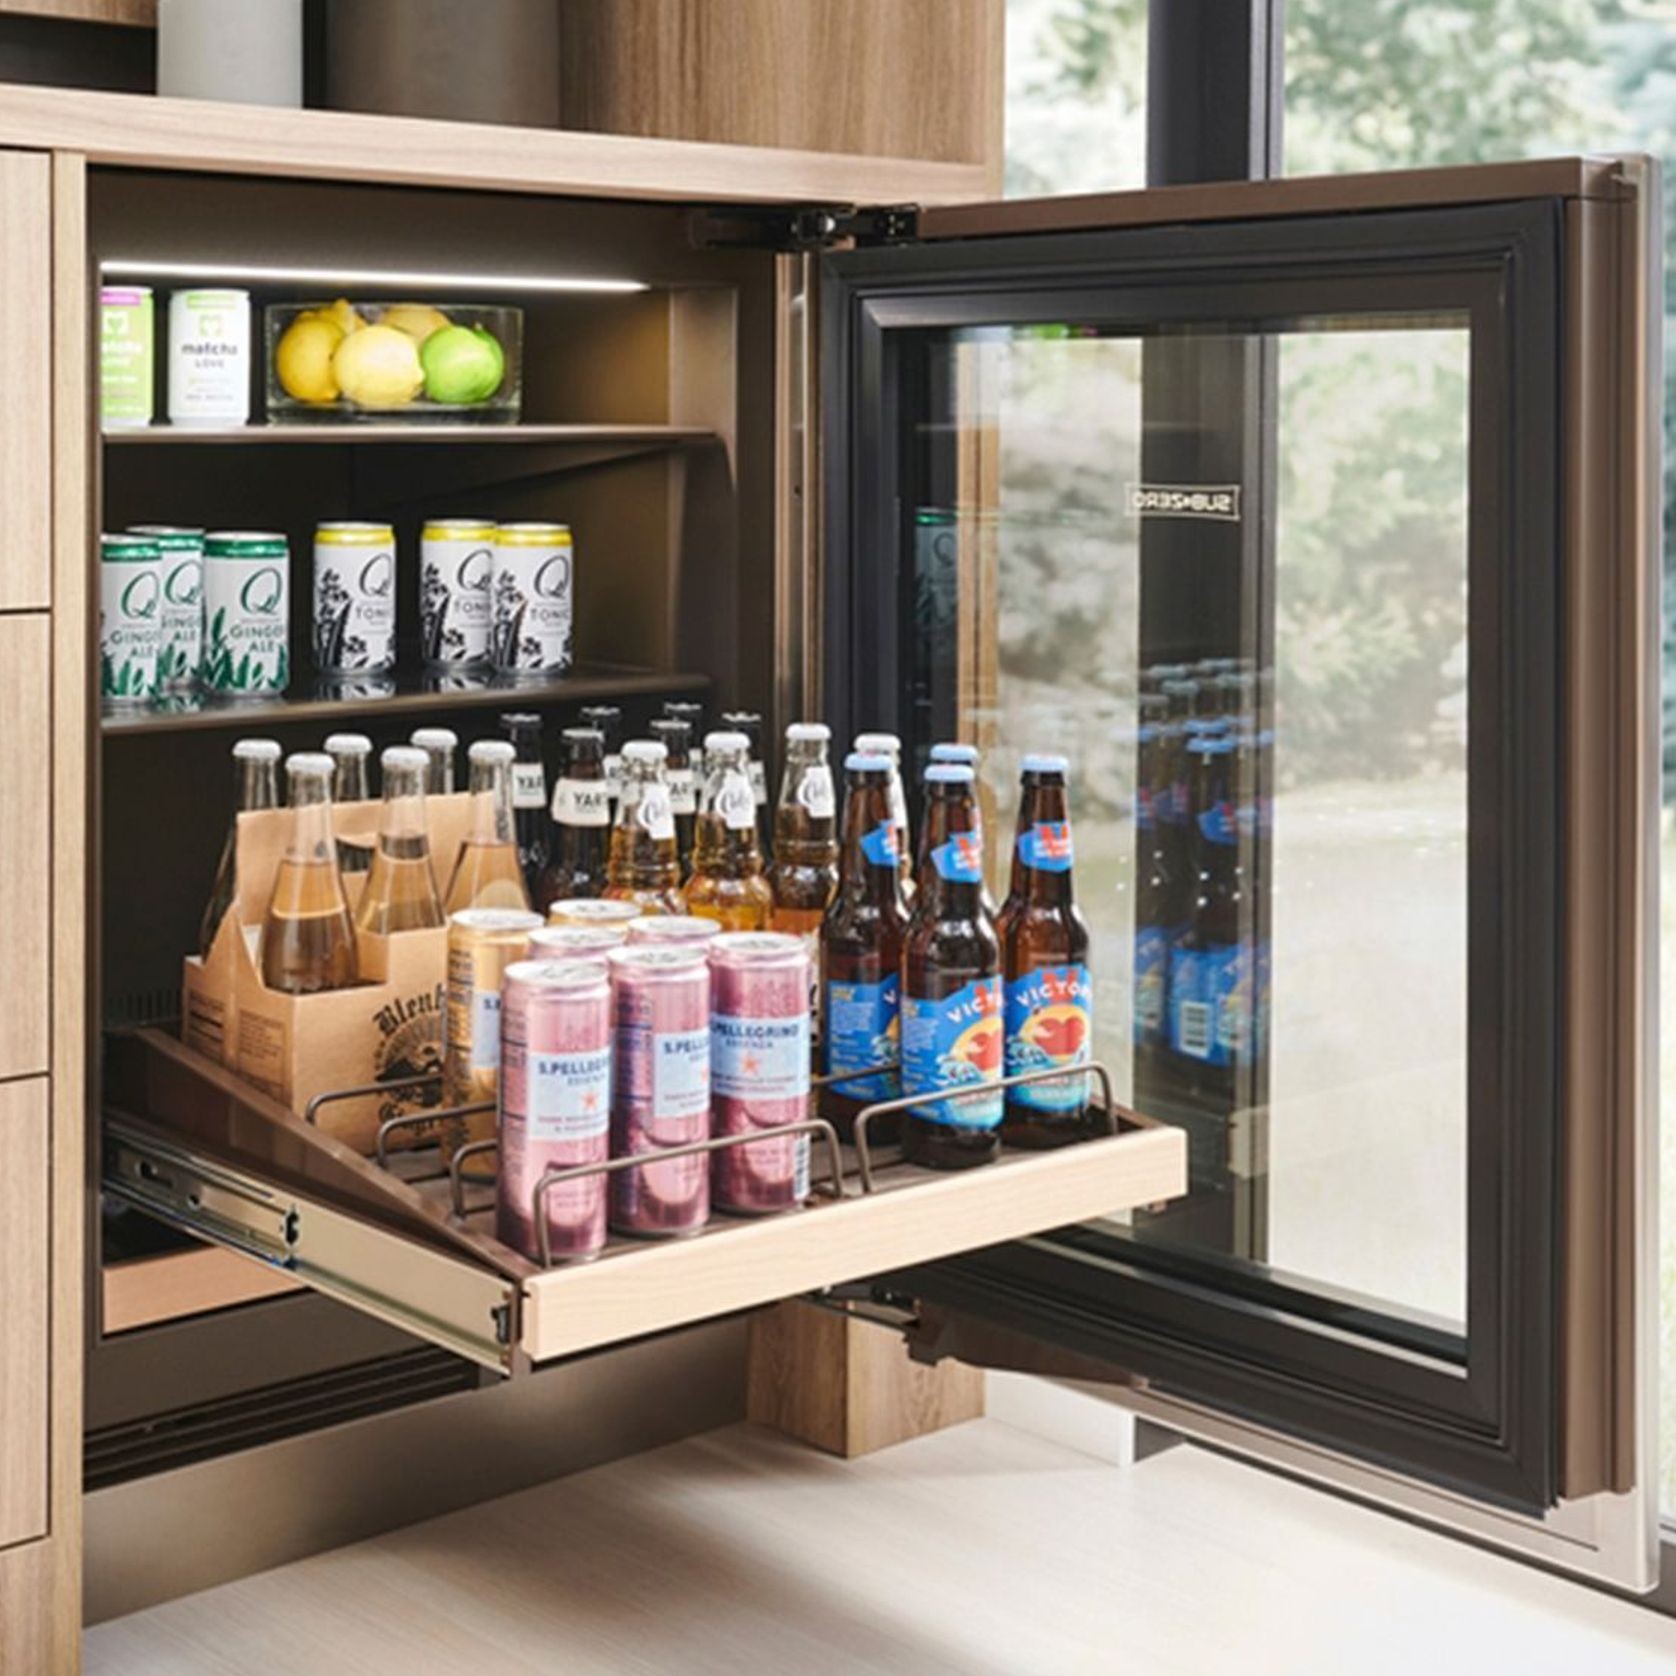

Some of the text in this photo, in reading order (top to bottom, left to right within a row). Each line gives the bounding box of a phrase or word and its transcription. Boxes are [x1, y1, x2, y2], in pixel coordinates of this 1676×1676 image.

[181, 341, 238, 356] matcha
[121, 570, 161, 620] Q
[164, 560, 201, 606] Q
[240, 567, 283, 616] Q
[358, 553, 393, 598] Q
[534, 555, 571, 599] Q
